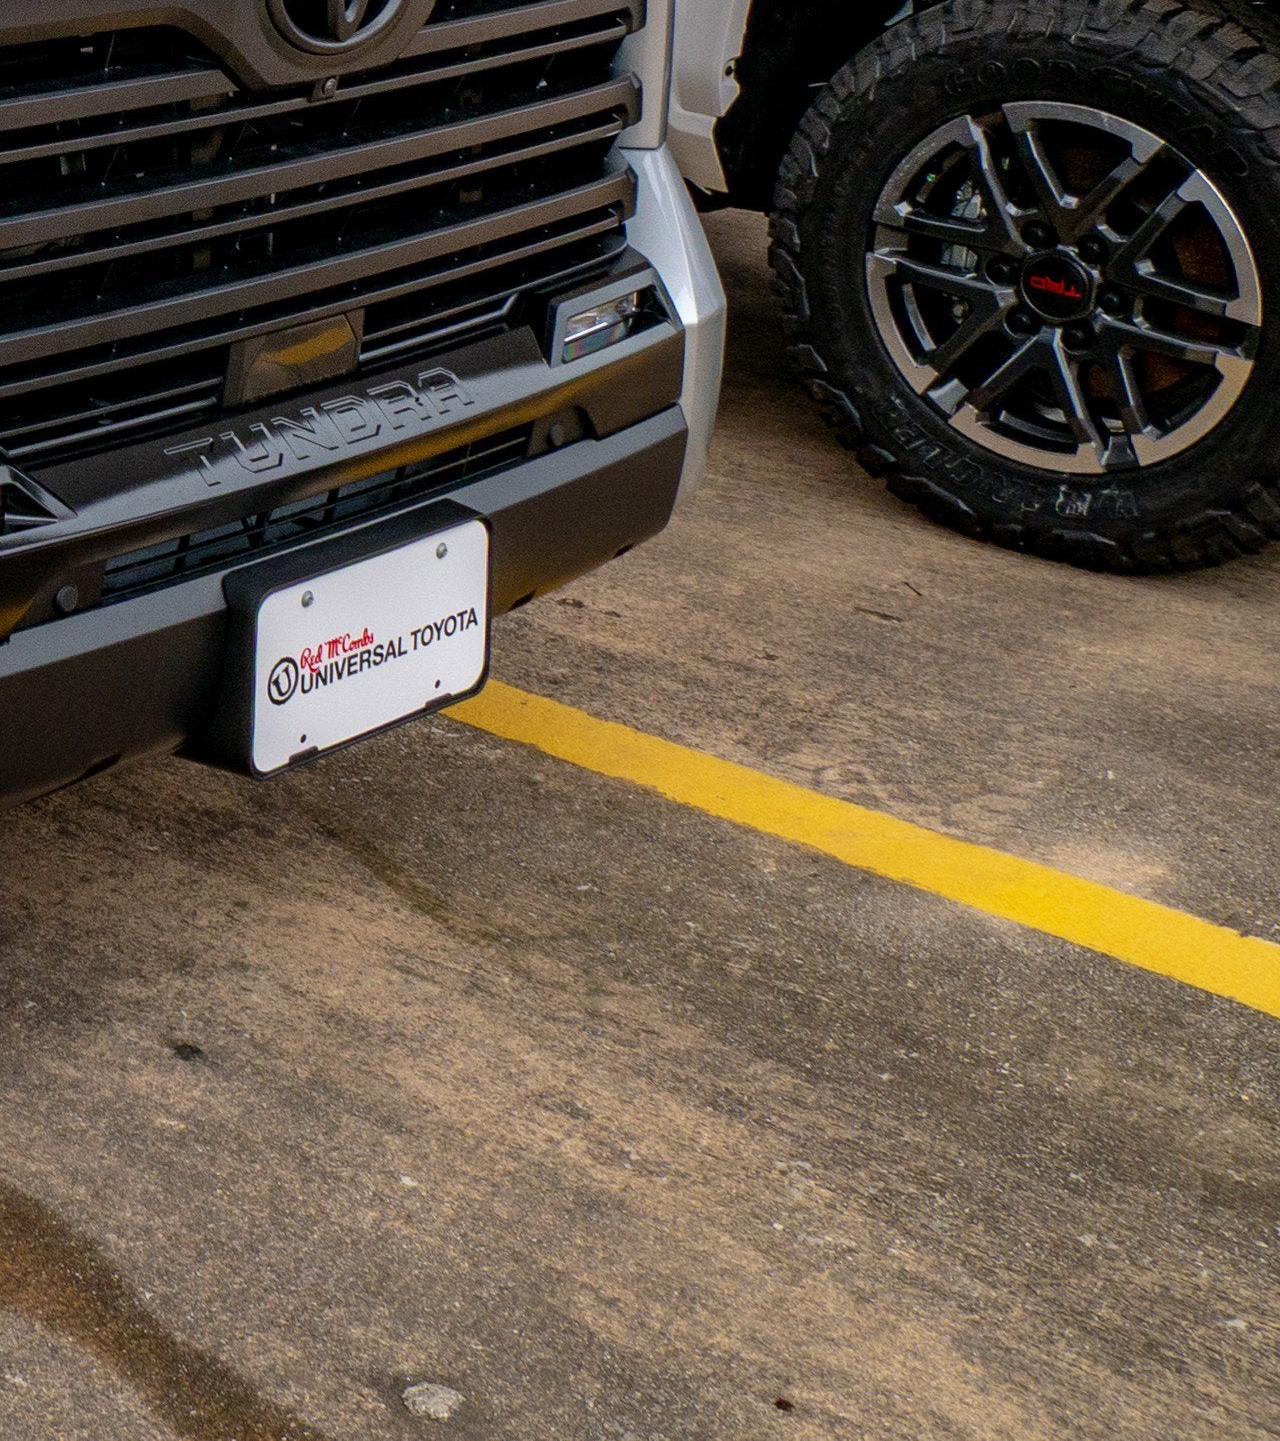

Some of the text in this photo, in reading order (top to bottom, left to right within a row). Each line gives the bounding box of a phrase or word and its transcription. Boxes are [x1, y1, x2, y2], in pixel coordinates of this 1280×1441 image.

[1030, 276, 1081, 298] TRD
[163, 366, 476, 488] TUNDRA
[300, 627, 374, 674] Red McCombs
[300, 607, 479, 694] UNIVERSAL TOYOTA
